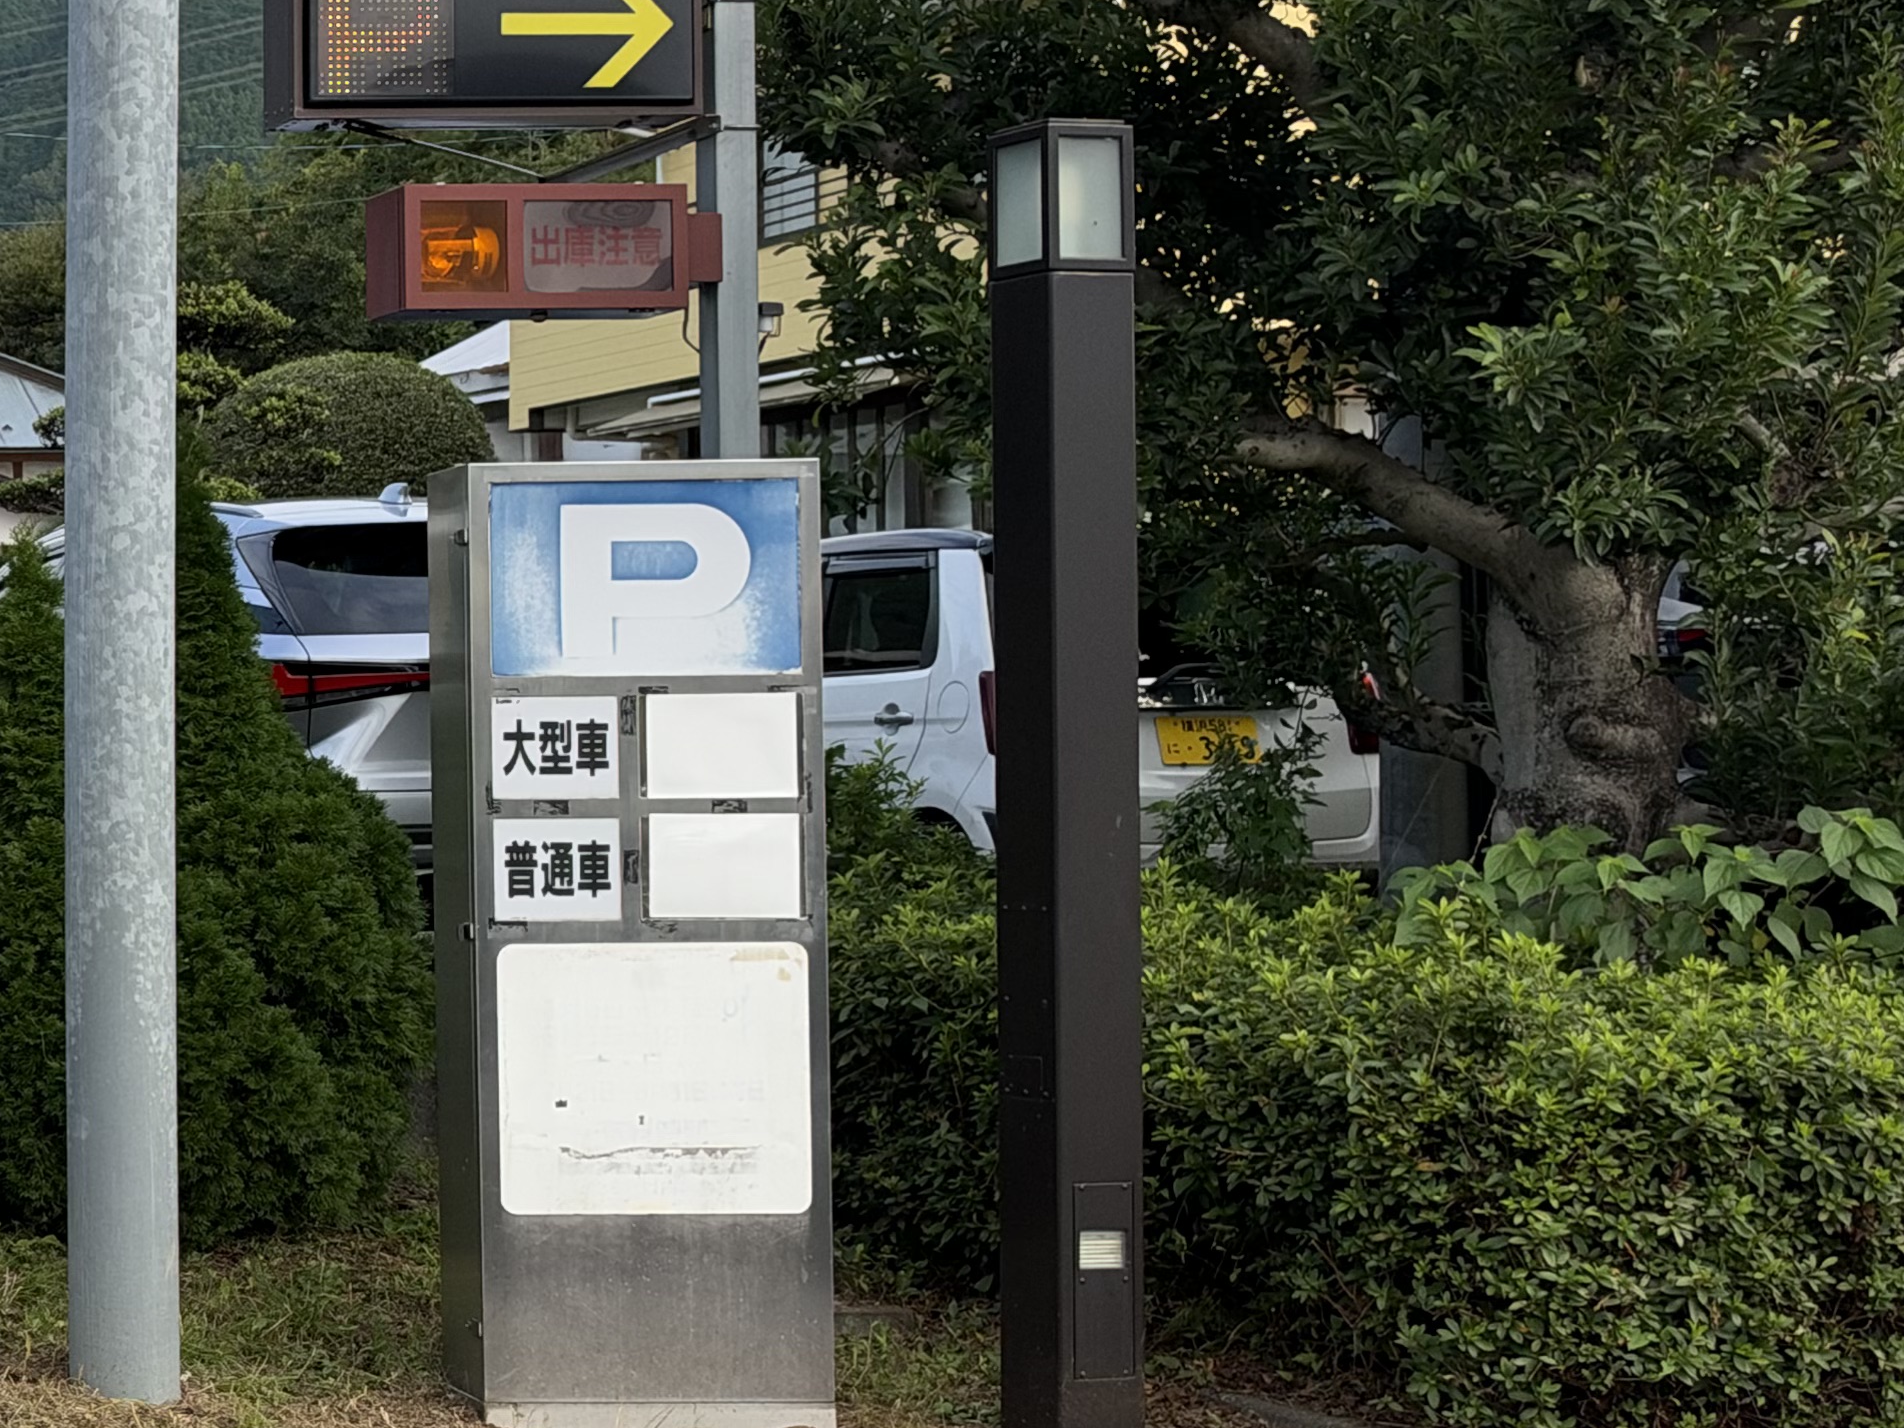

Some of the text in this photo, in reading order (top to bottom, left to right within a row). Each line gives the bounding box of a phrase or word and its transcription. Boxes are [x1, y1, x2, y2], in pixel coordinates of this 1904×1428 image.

[529, 223, 663, 268] 出庫注意
[503, 718, 610, 777] 大型車
[504, 839, 612, 899] 普通車
